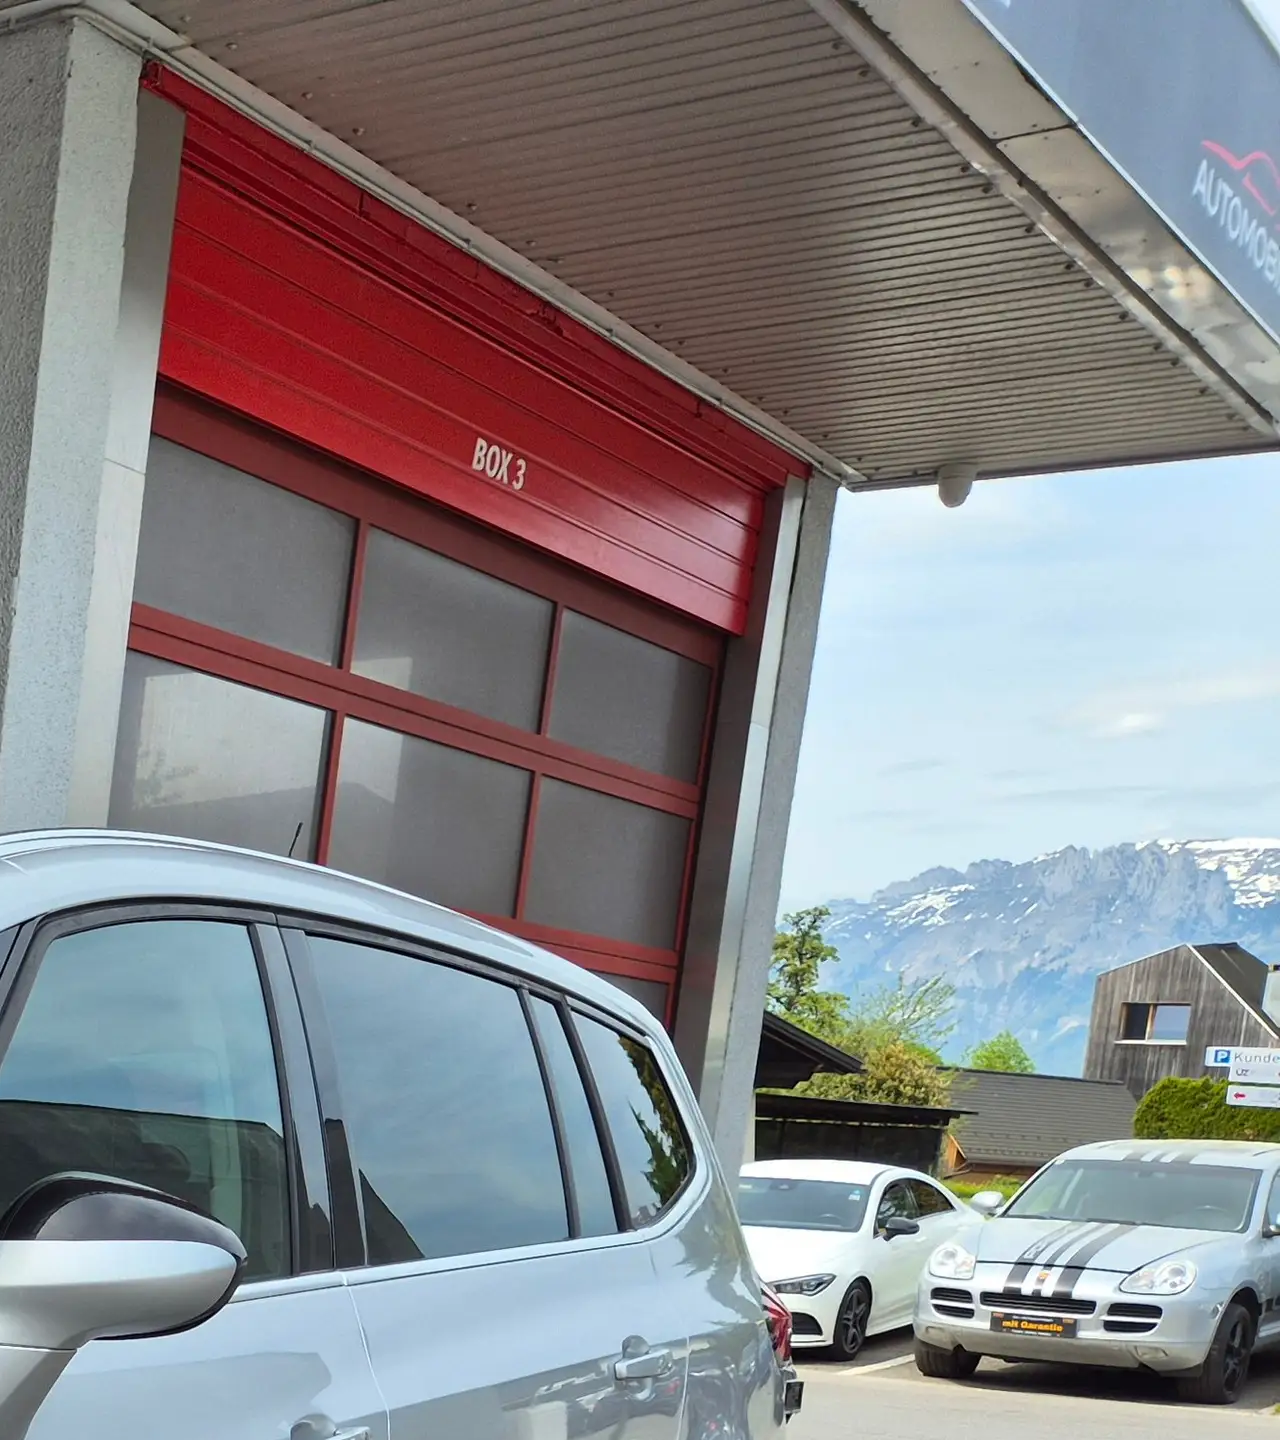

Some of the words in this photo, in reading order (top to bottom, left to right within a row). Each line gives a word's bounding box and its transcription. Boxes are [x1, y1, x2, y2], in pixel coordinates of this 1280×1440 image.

[472, 437, 513, 484] BOX
[512, 459, 526, 490] 3
[1002, 1320, 1019, 1328] mit
[1021, 1321, 1063, 1332] Garantie
